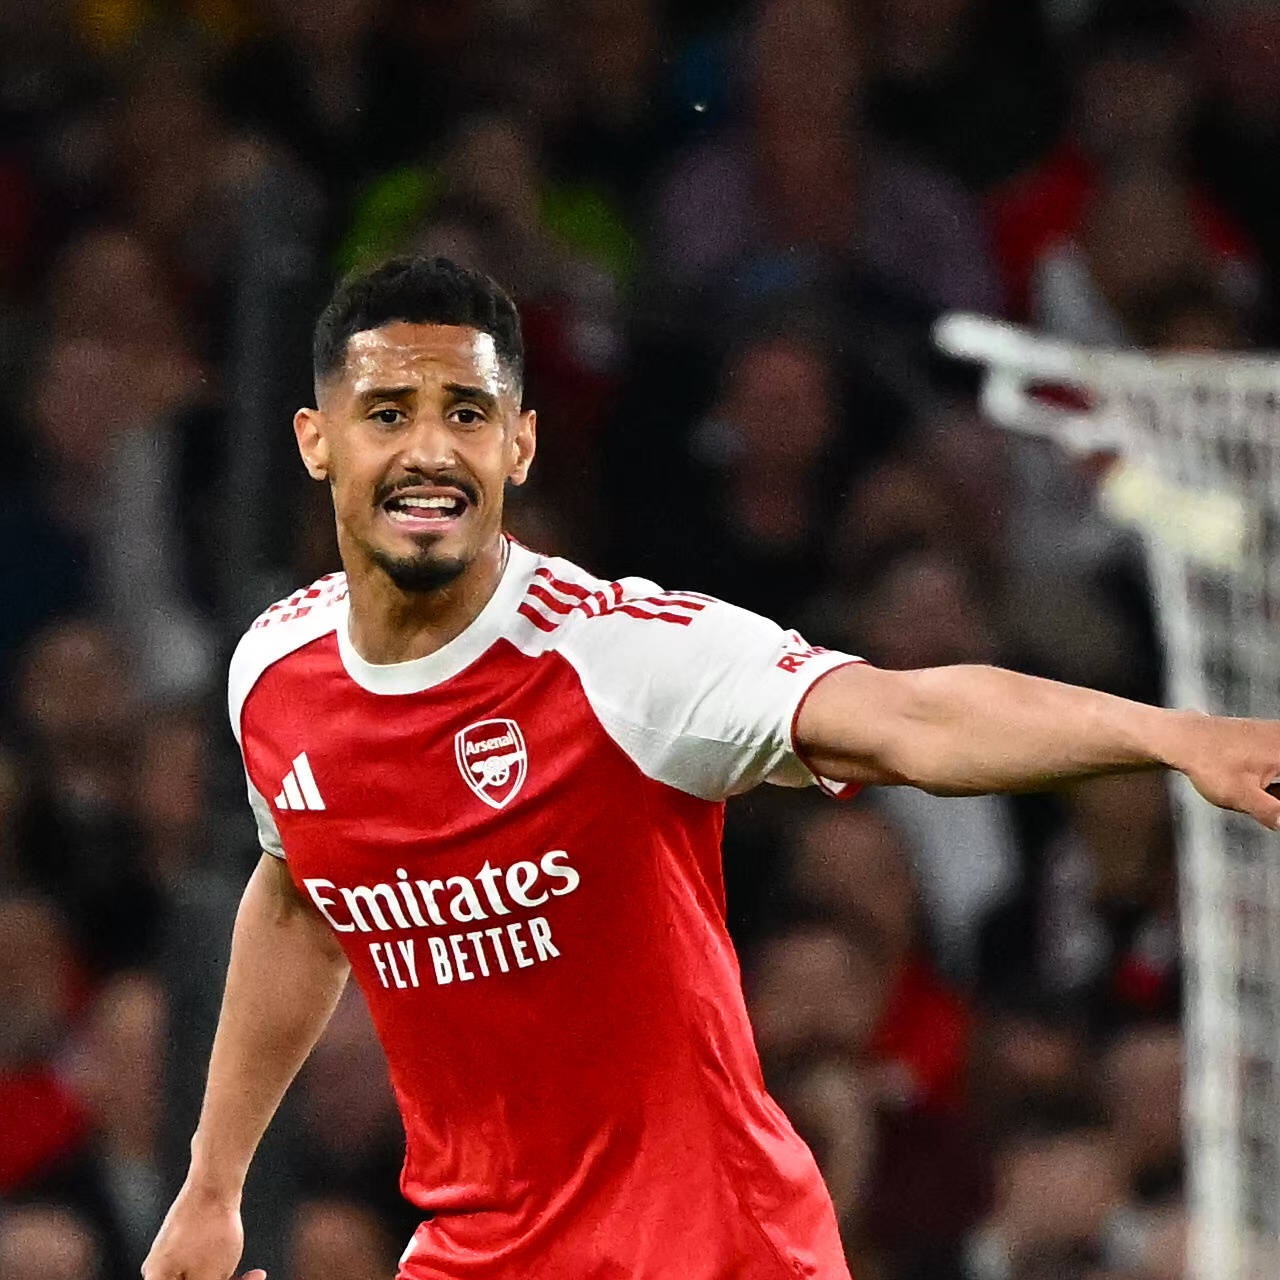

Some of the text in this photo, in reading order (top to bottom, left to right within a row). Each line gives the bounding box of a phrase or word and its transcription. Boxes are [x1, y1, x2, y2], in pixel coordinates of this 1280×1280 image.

[465, 730, 515, 756] Arsenal
[302, 850, 580, 932] Emirates
[369, 916, 561, 989] FLY BETTER
